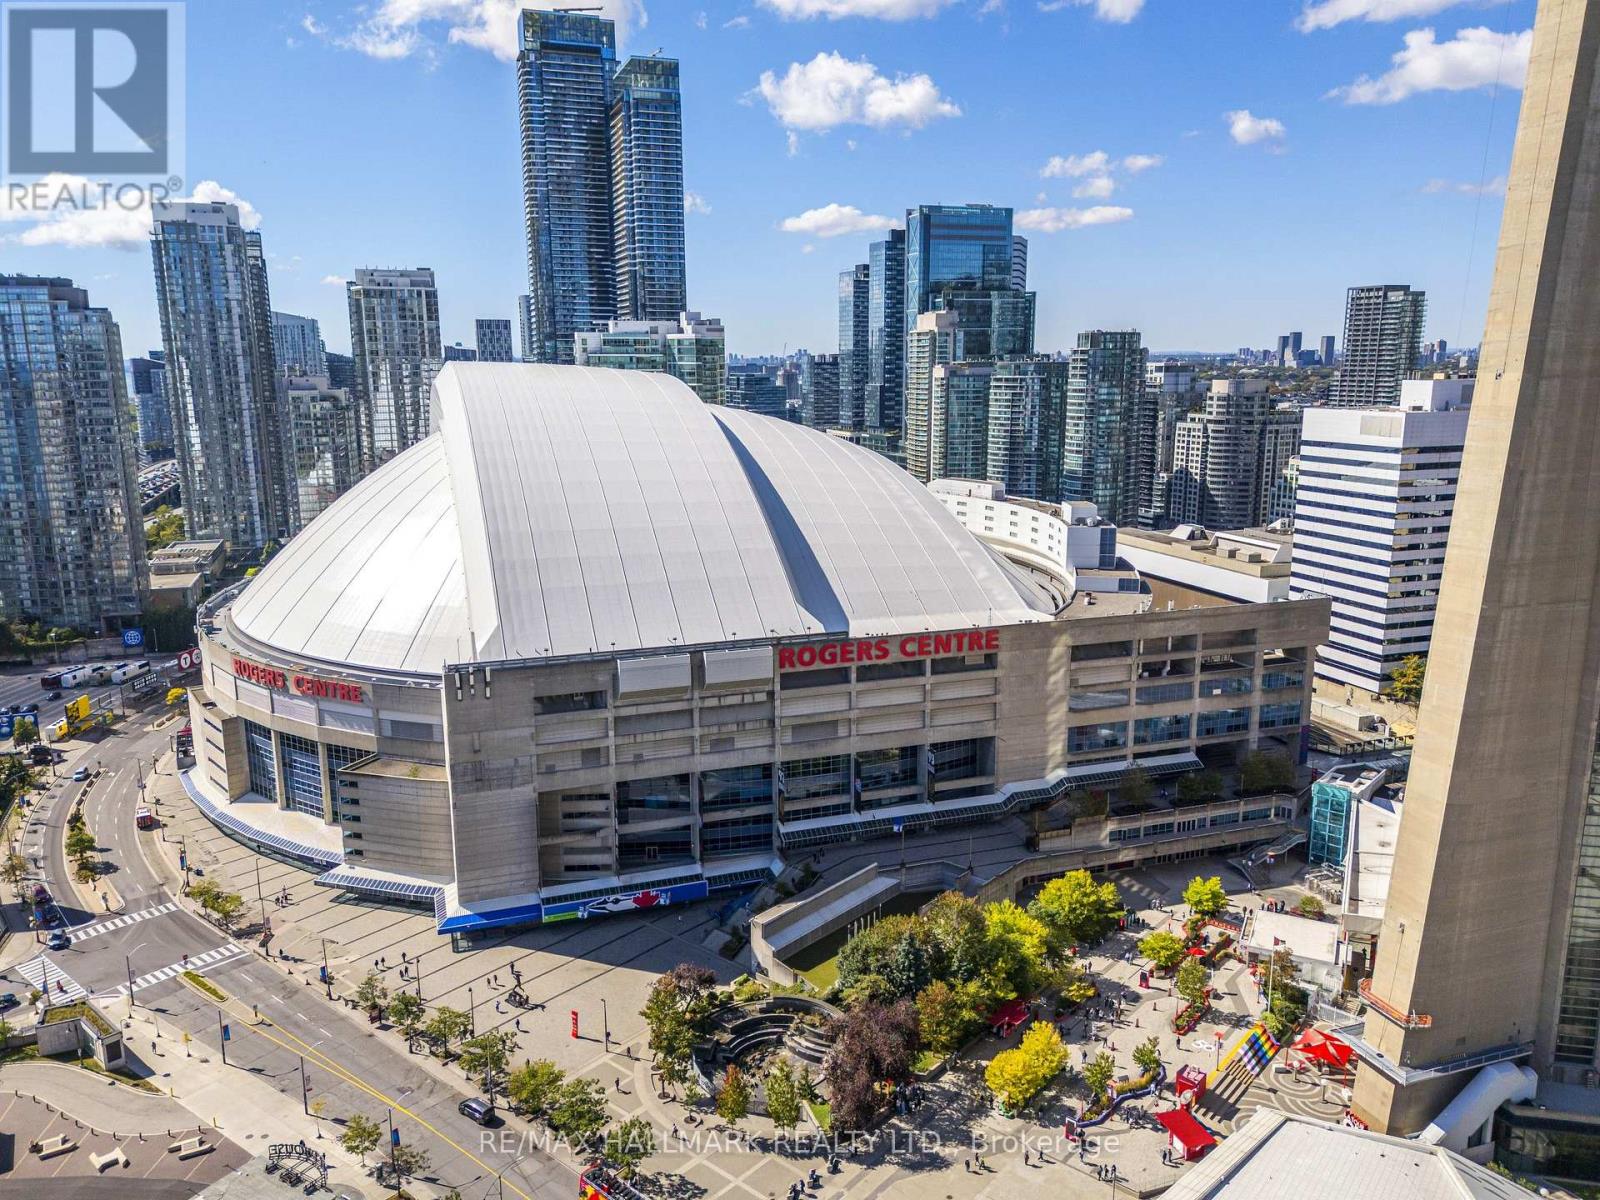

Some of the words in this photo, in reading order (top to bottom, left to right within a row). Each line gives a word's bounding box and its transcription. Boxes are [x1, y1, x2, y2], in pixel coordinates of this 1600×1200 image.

[778, 639, 890, 668] ROGERS
[900, 629, 999, 657] CENTRE
[232, 658, 286, 689] ROGERS
[293, 674, 363, 704] CENTRE
